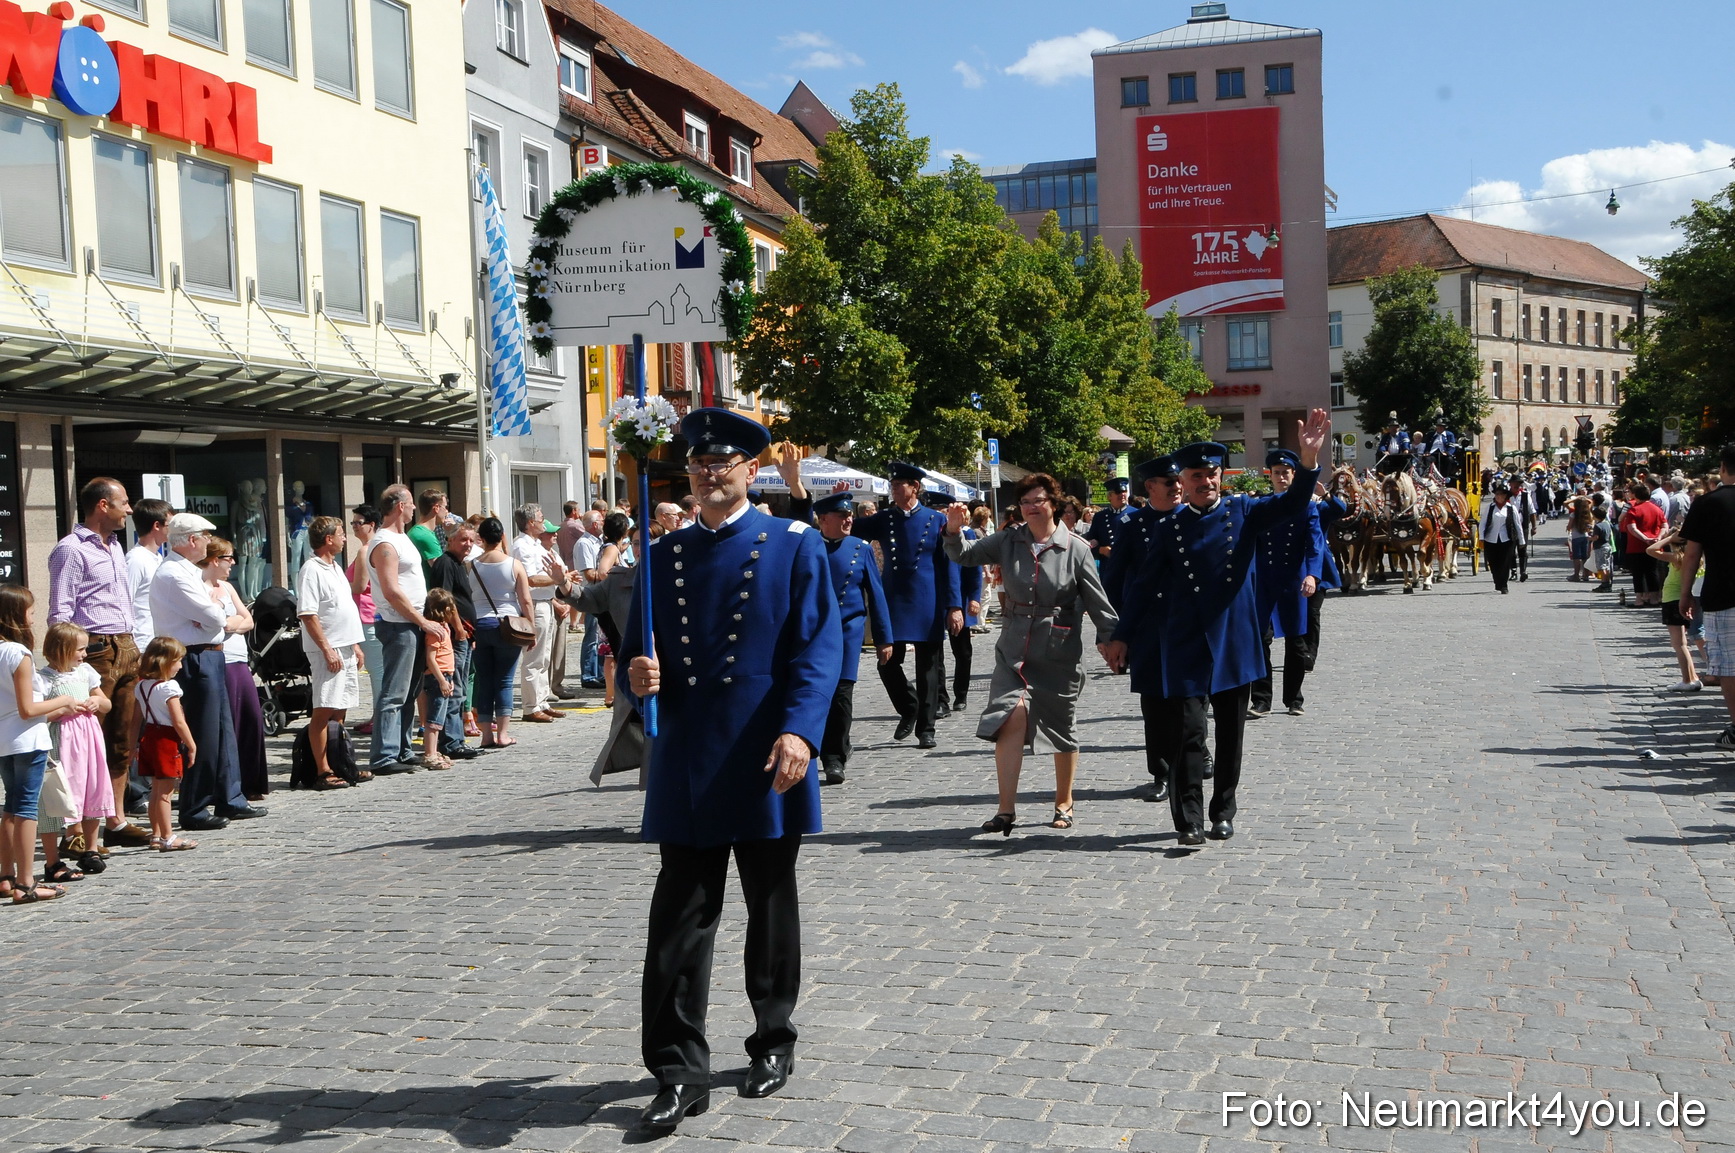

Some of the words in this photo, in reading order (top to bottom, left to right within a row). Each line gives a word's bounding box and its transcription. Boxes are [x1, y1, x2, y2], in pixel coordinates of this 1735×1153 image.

[0, 0, 272, 164] WÖHRL
[584, 148, 599, 164] B
[1148, 162, 1198, 178] Danke
[1148, 186, 1162, 195] für
[1165, 185, 1179, 194] Ihr
[1181, 183, 1232, 193] Vertrauen
[1148, 199, 1168, 209] und
[1171, 198, 1191, 208] Ihre
[1193, 197, 1225, 207] Treue.
[556, 244, 612, 257] Museum
[622, 240, 646, 254] für
[1192, 231, 1239, 252] 175
[1193, 251, 1239, 265] JAHRE
[553, 259, 671, 276] Kommunikation
[1193, 269, 1220, 277] Sparkasse
[553, 279, 626, 295] Nürnberg
[753, 477, 767, 485] kler
[769, 476, 784, 485] Bräu
[811, 477, 836, 486] Winkler
[186, 497, 220, 514] Aktion
[0, 550, 13, 558] ORE
